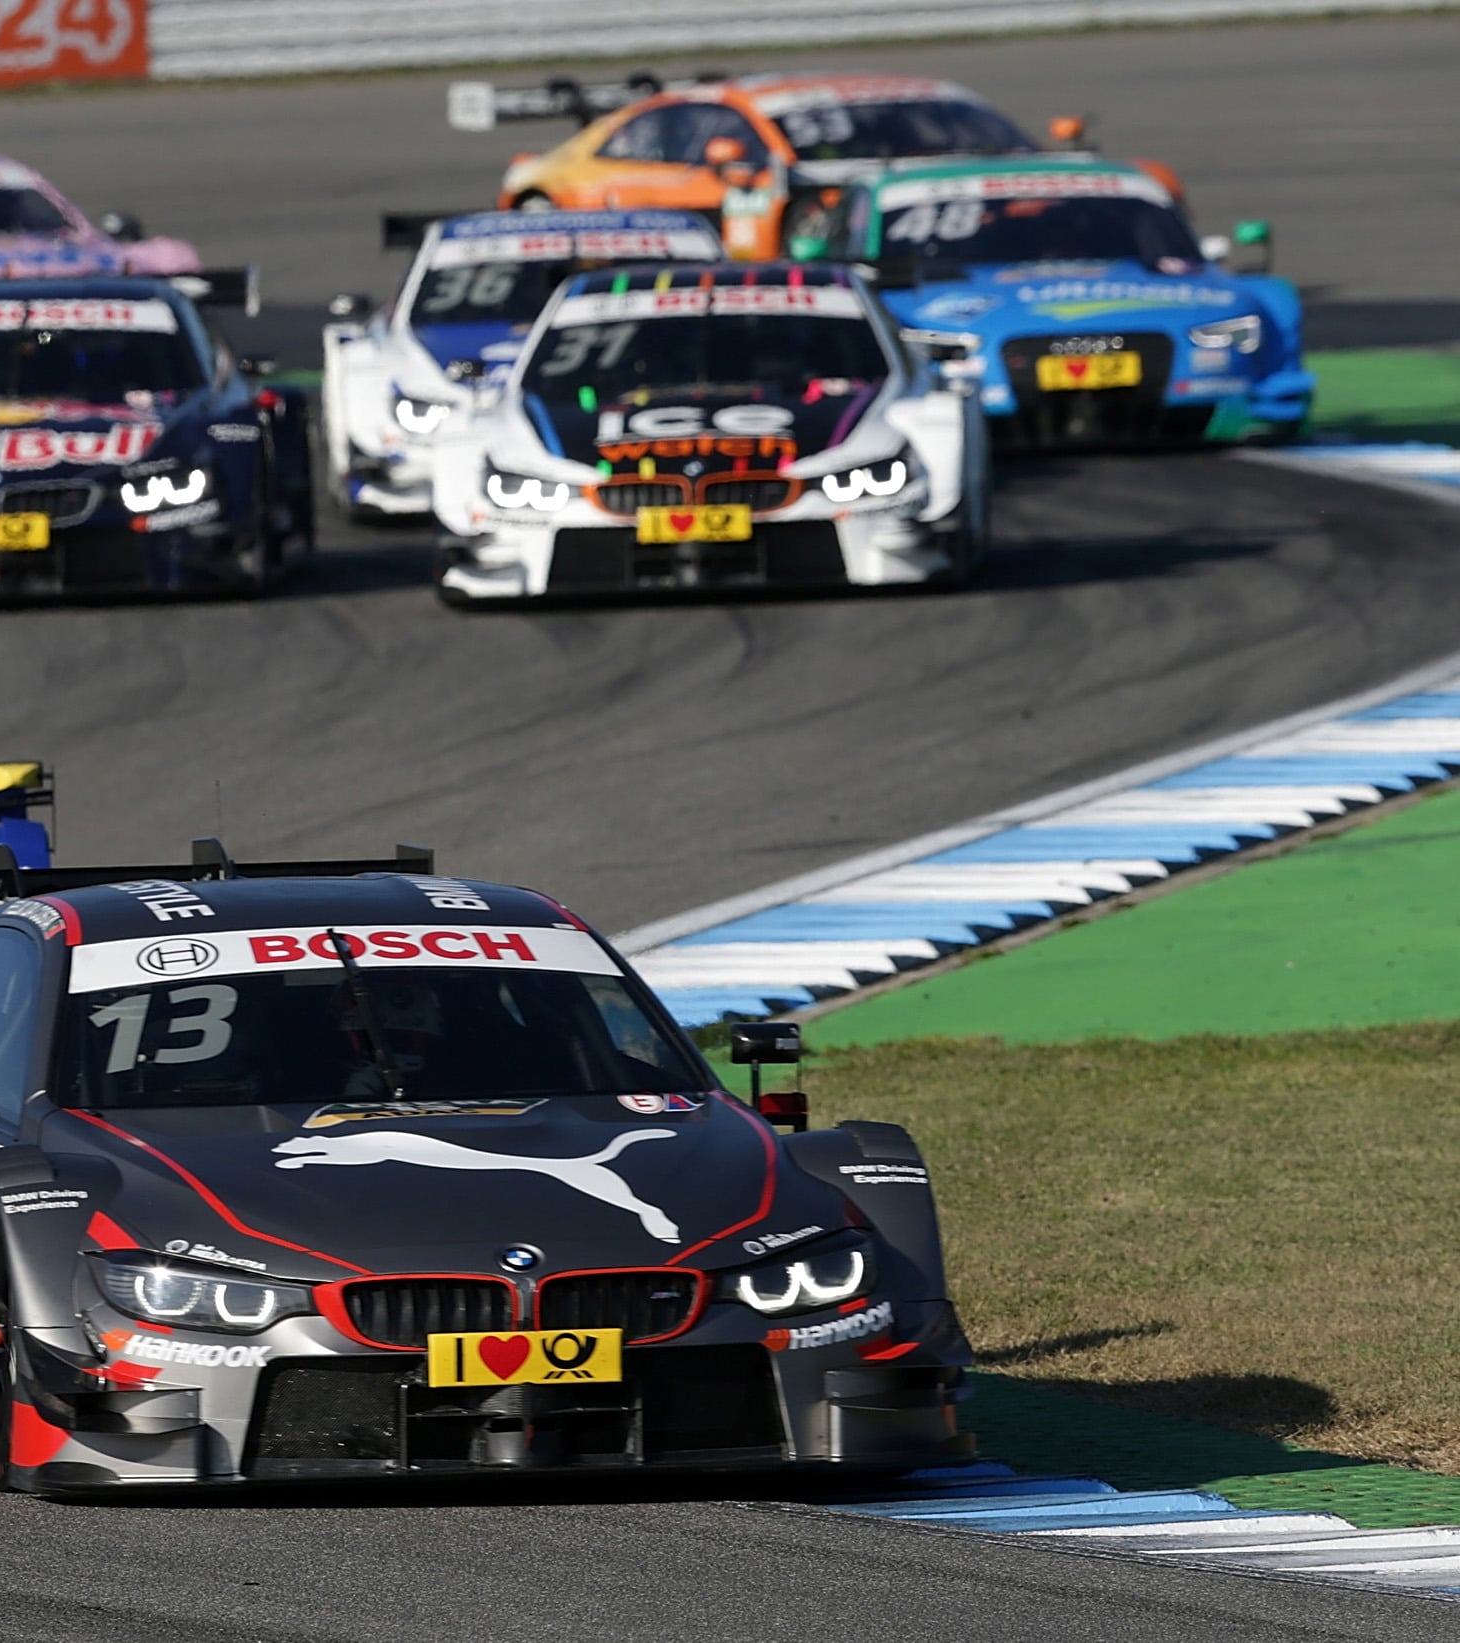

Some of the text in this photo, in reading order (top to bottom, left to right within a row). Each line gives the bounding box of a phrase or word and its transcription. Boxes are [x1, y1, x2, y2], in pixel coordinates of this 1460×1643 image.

[887, 201, 985, 242] 48
[424, 263, 517, 311] 36
[248, 930, 538, 965] BOSCH
[88, 983, 239, 1074] 13
[39, 1189, 89, 1200] Driving
[852, 1174, 929, 1184] Experience
[3, 1200, 80, 1215] Experience
